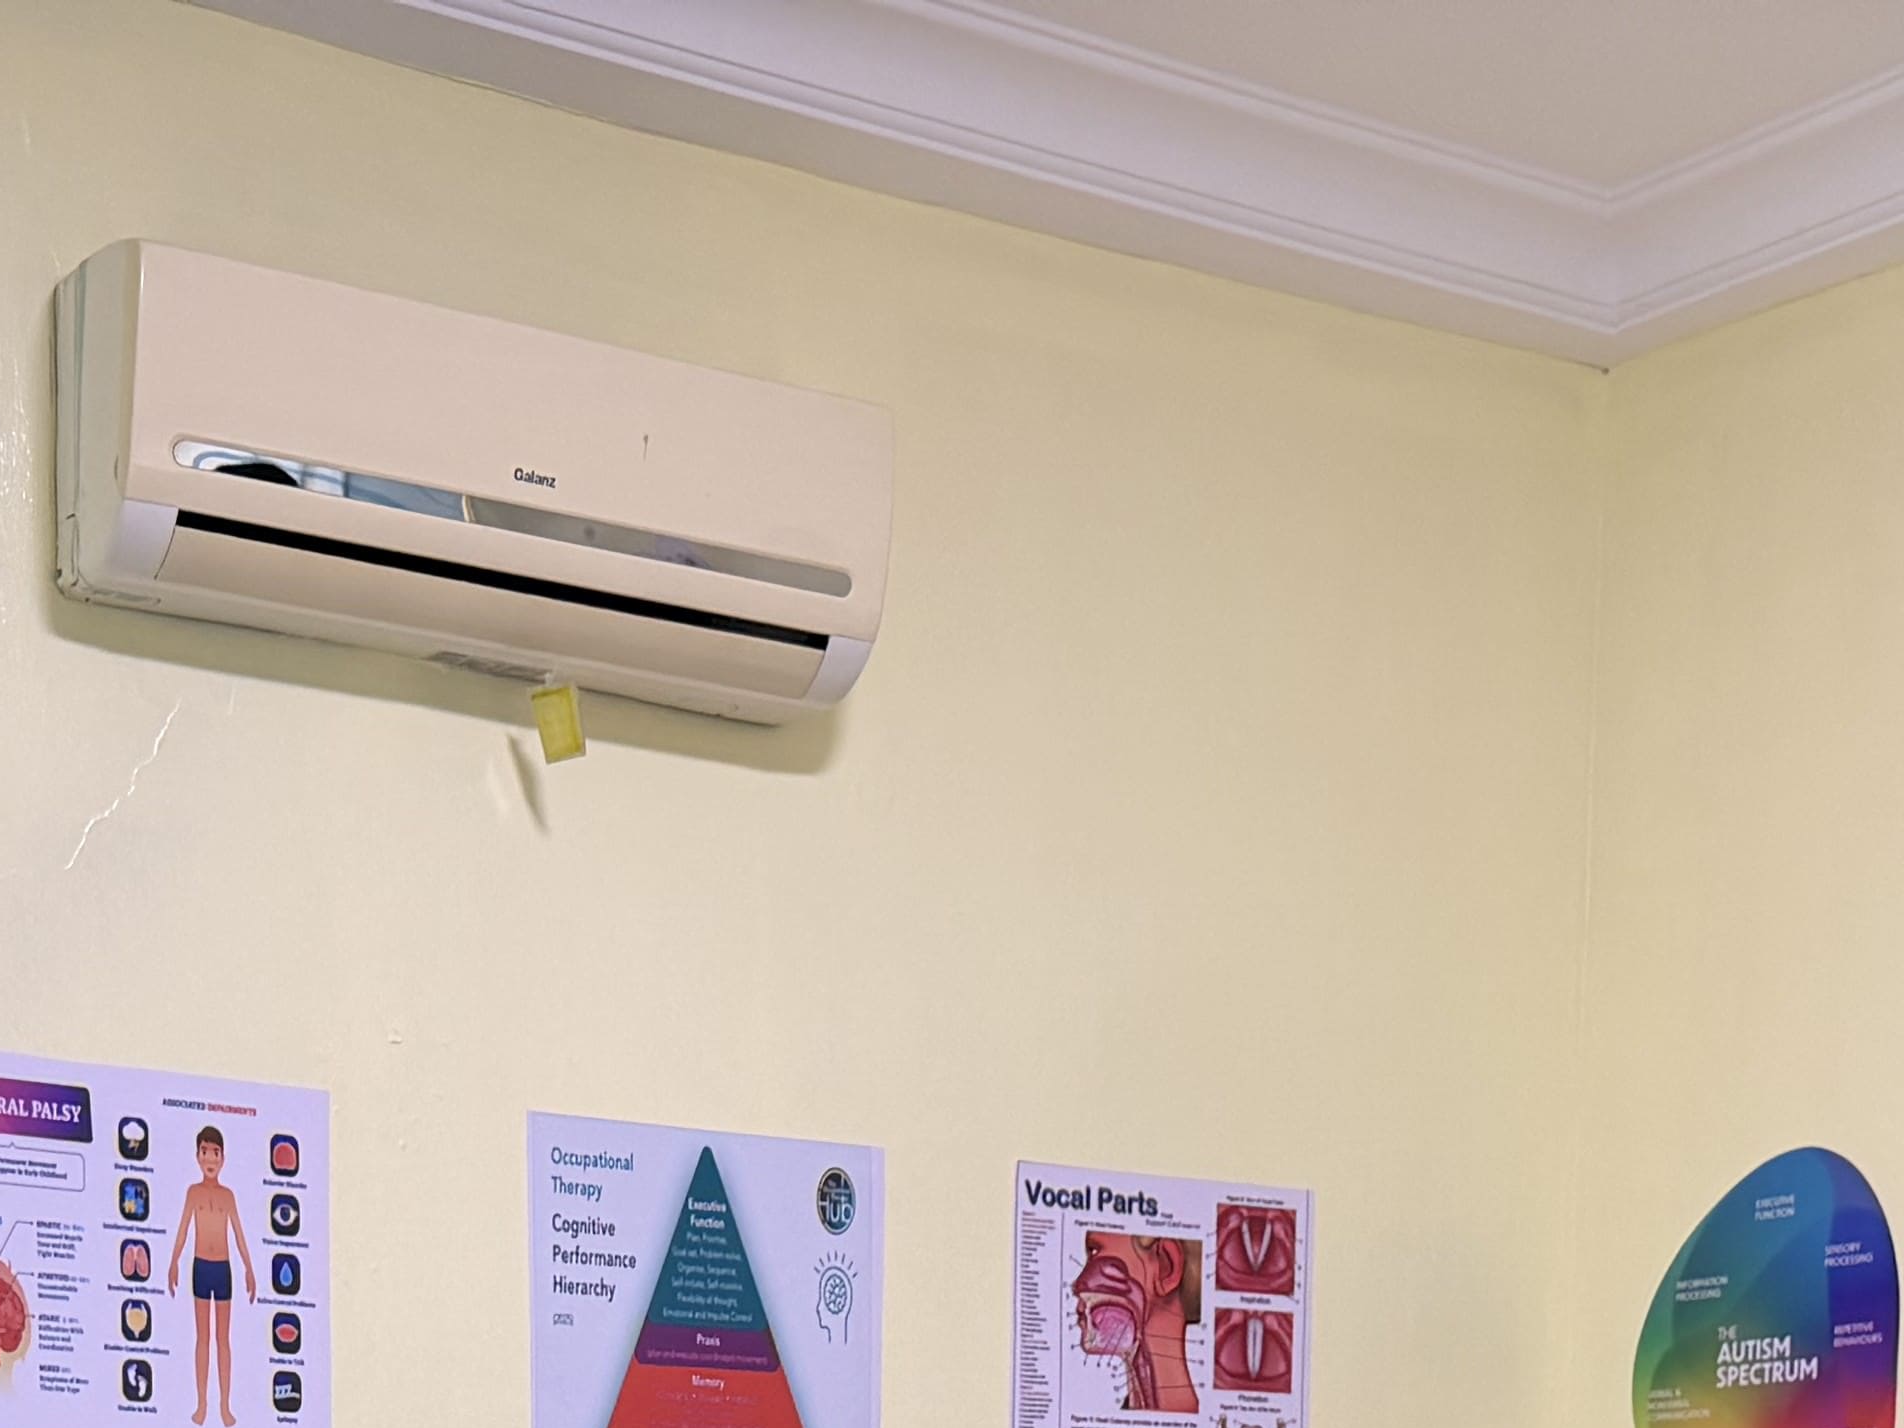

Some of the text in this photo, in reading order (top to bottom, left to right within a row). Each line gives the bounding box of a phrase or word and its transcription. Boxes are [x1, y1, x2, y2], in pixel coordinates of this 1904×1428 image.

[514, 467, 556, 488] Galanz
[32, 1100, 82, 1123] PALSY
[551, 1147, 634, 1172] Occupational
[551, 1176, 603, 1201] Therapy
[1026, 1179, 1158, 1217] Vocal Parts
[688, 1199, 727, 1213] Executive
[552, 1214, 616, 1239] Cognitive
[690, 1215, 725, 1229] Function
[552, 1244, 637, 1269] Performance
[553, 1275, 616, 1303] Hierarchy
[696, 1334, 721, 1347] Praxis
[1718, 1325, 1737, 1340] THE
[1717, 1336, 1792, 1364] AUTISM
[692, 1375, 724, 1390] Memory
[1716, 1356, 1818, 1388] SPECTRUM
